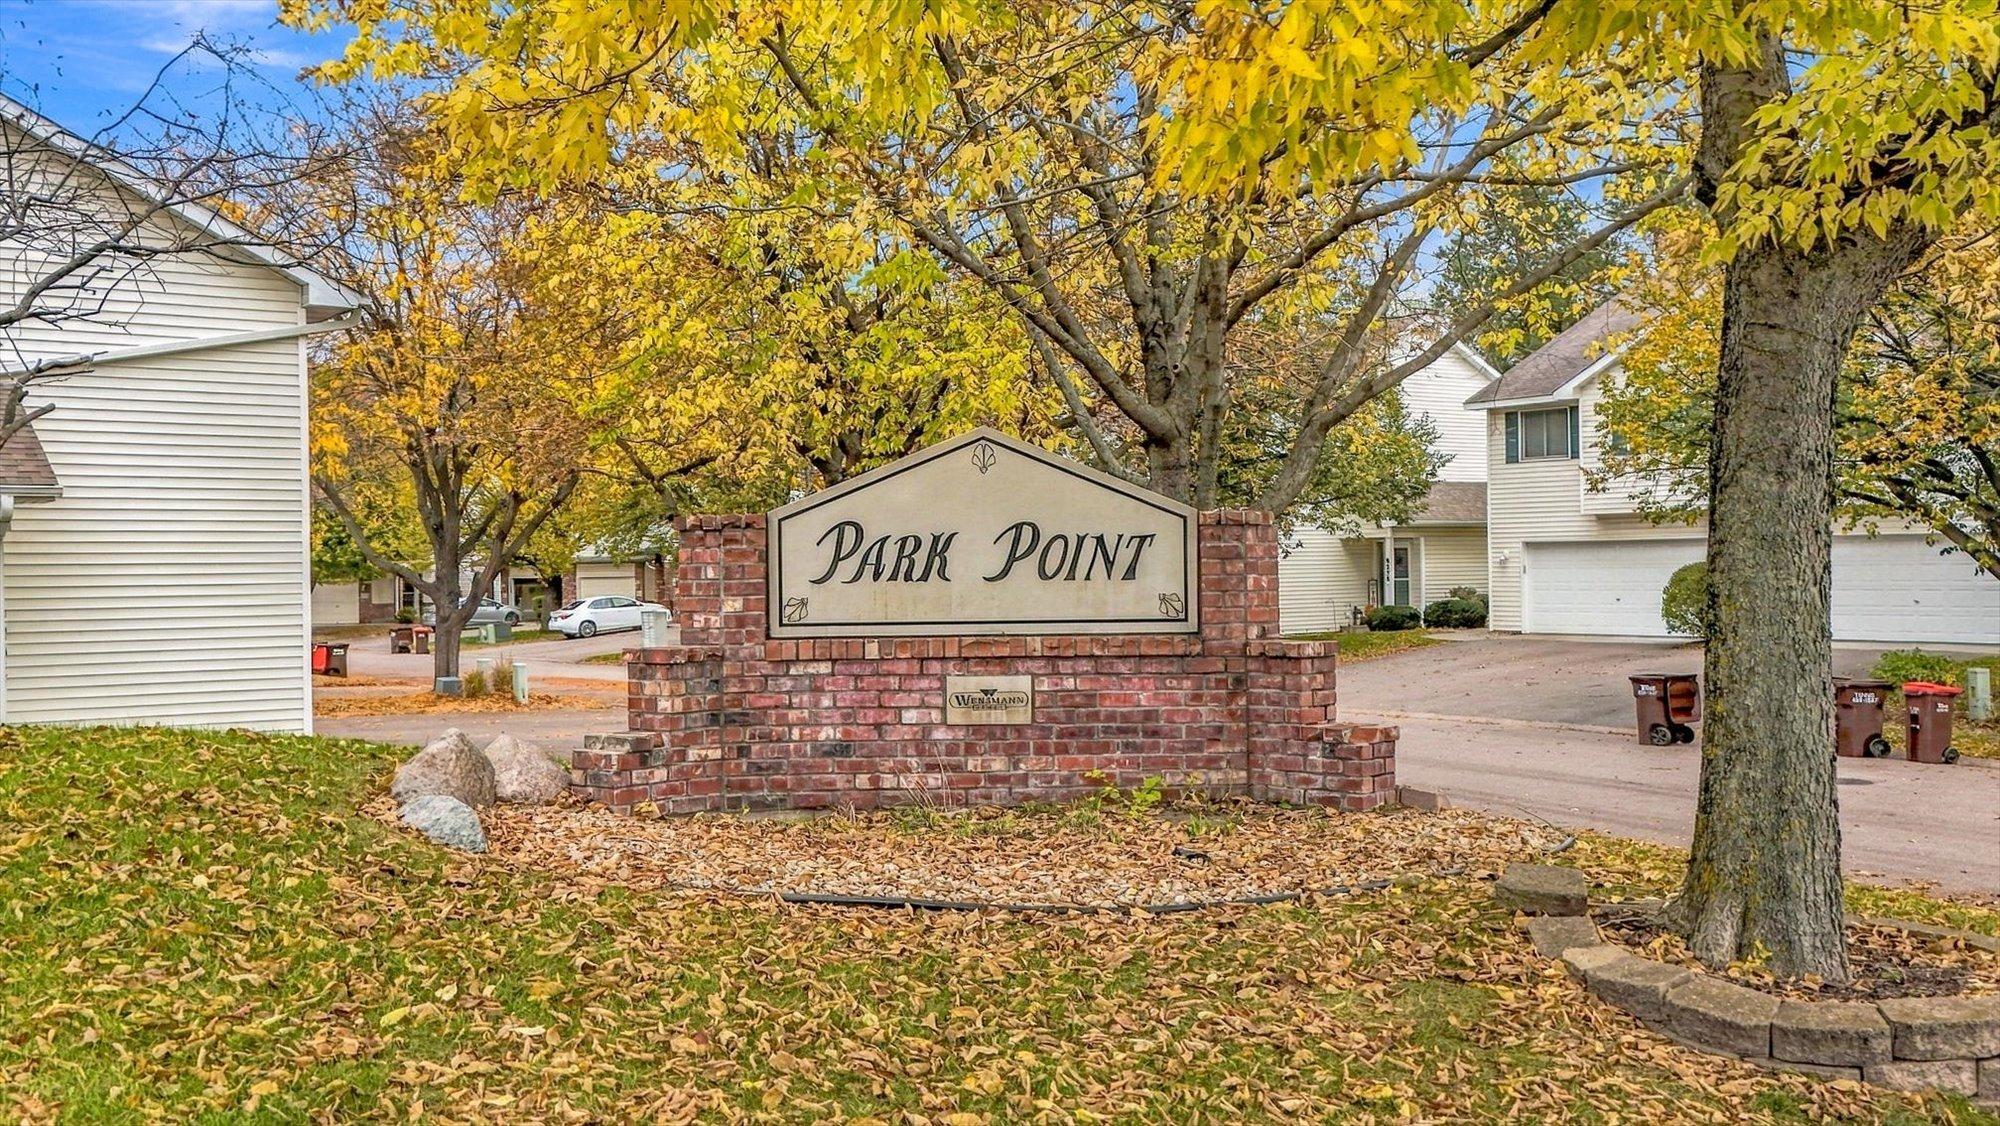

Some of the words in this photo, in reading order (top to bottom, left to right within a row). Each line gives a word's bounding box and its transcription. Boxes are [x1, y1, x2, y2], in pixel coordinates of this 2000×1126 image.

[808, 520, 960, 585] PARK
[982, 520, 1157, 583] POINT
[954, 694, 1025, 707] WENSMANN
